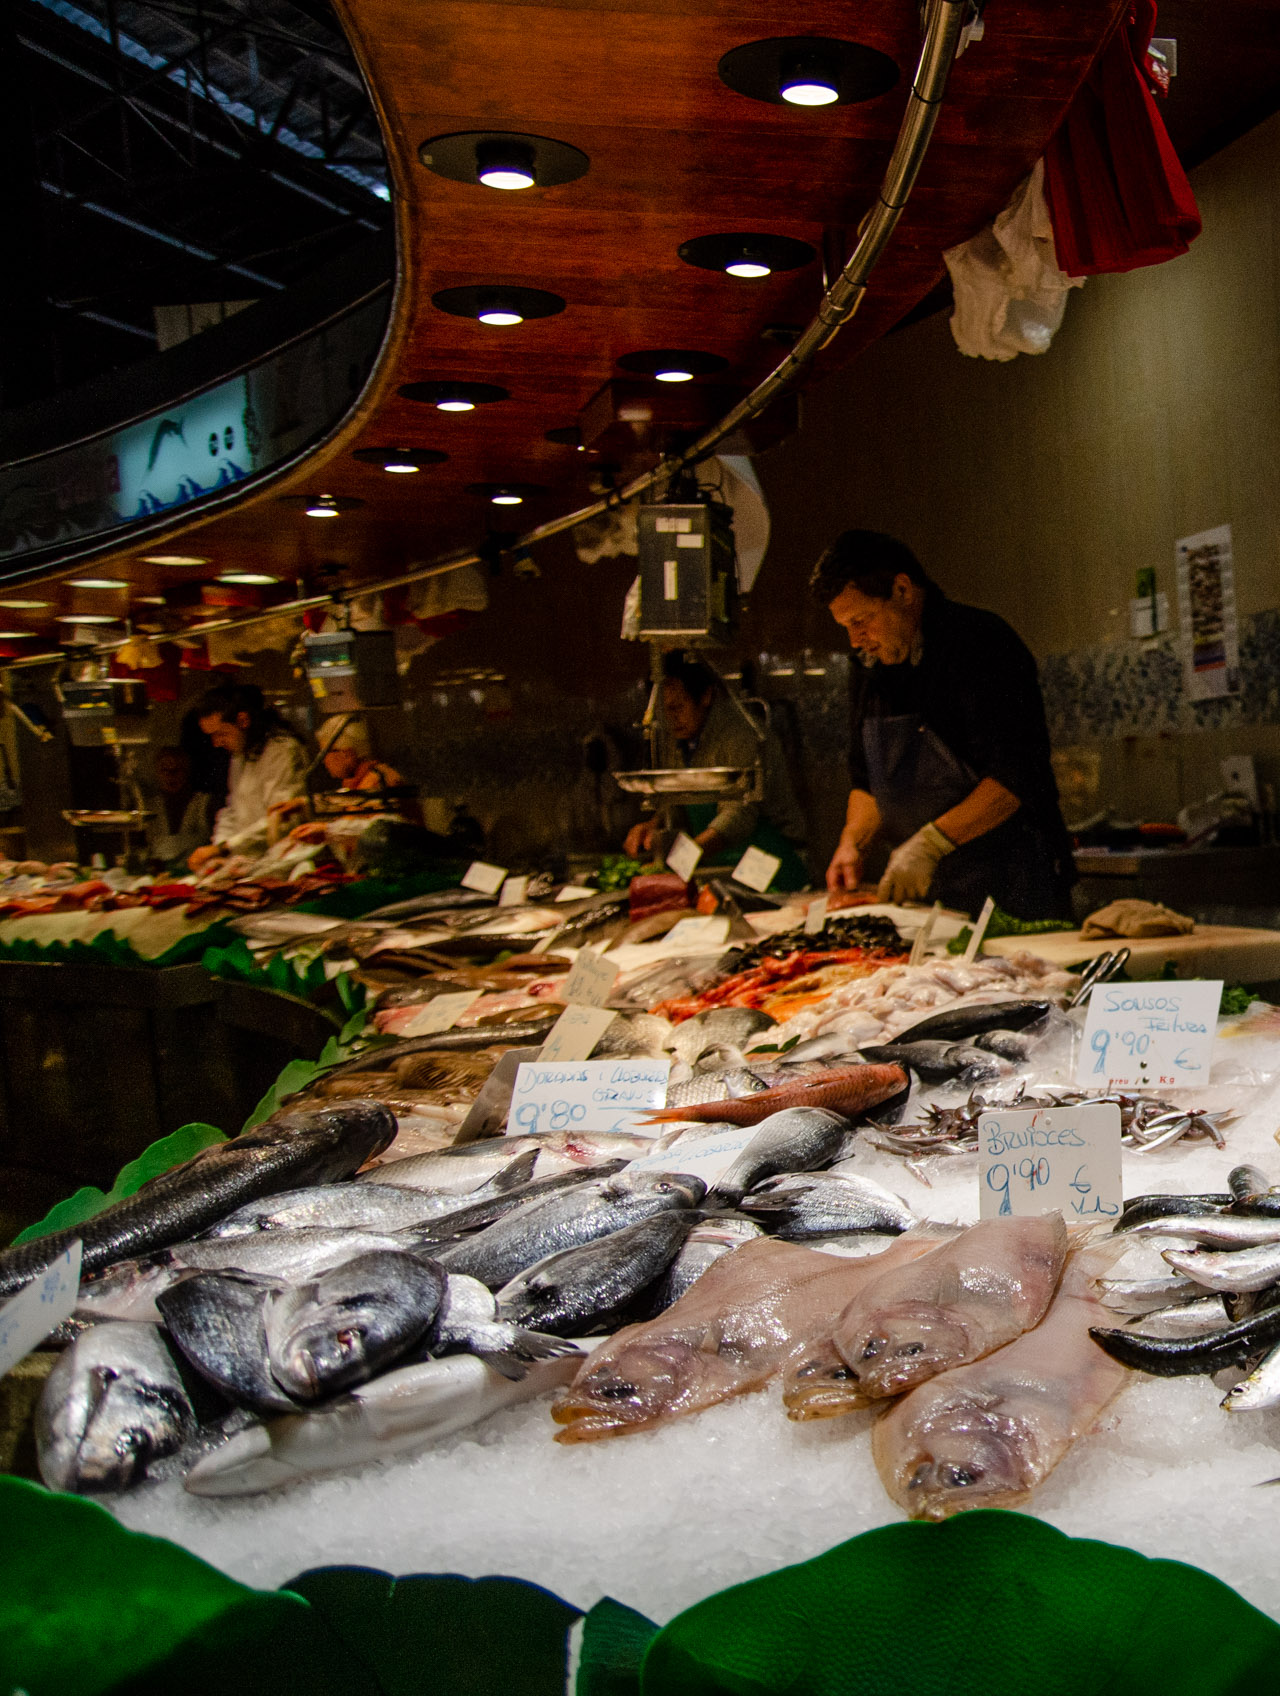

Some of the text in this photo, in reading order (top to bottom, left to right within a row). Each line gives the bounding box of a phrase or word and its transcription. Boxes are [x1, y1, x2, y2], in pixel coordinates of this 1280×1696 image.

[1090, 1029, 1150, 1075] 9'90
[515, 1100, 586, 1134] 9'80
[987, 1158, 1050, 1216] 9'90
